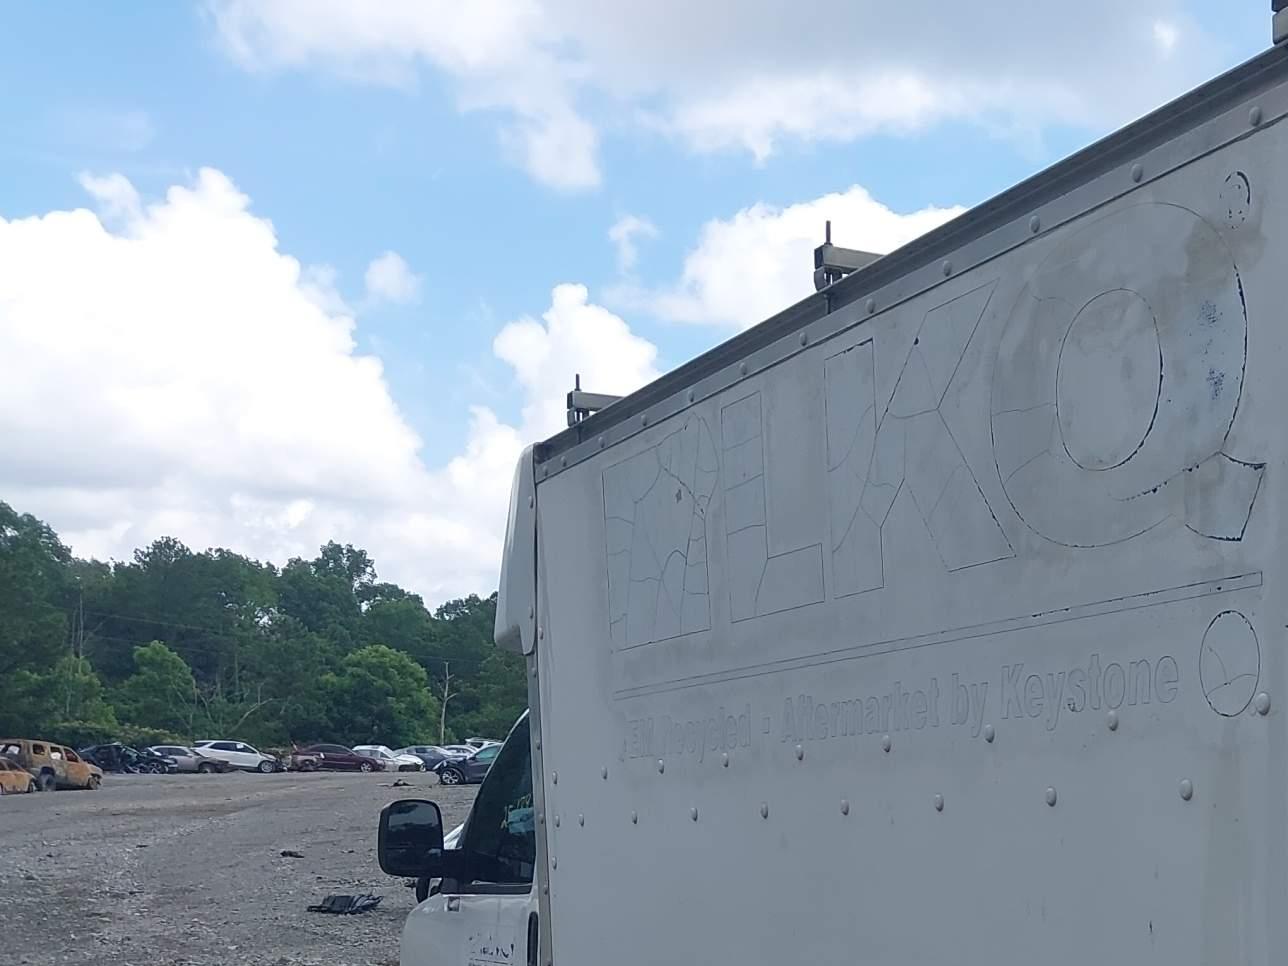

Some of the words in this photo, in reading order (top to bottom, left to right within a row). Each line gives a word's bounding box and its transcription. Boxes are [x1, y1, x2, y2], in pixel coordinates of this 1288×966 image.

[780, 678, 940, 743] Aftermarket
[952, 673, 989, 738] by
[1001, 654, 1180, 732] Keystone
